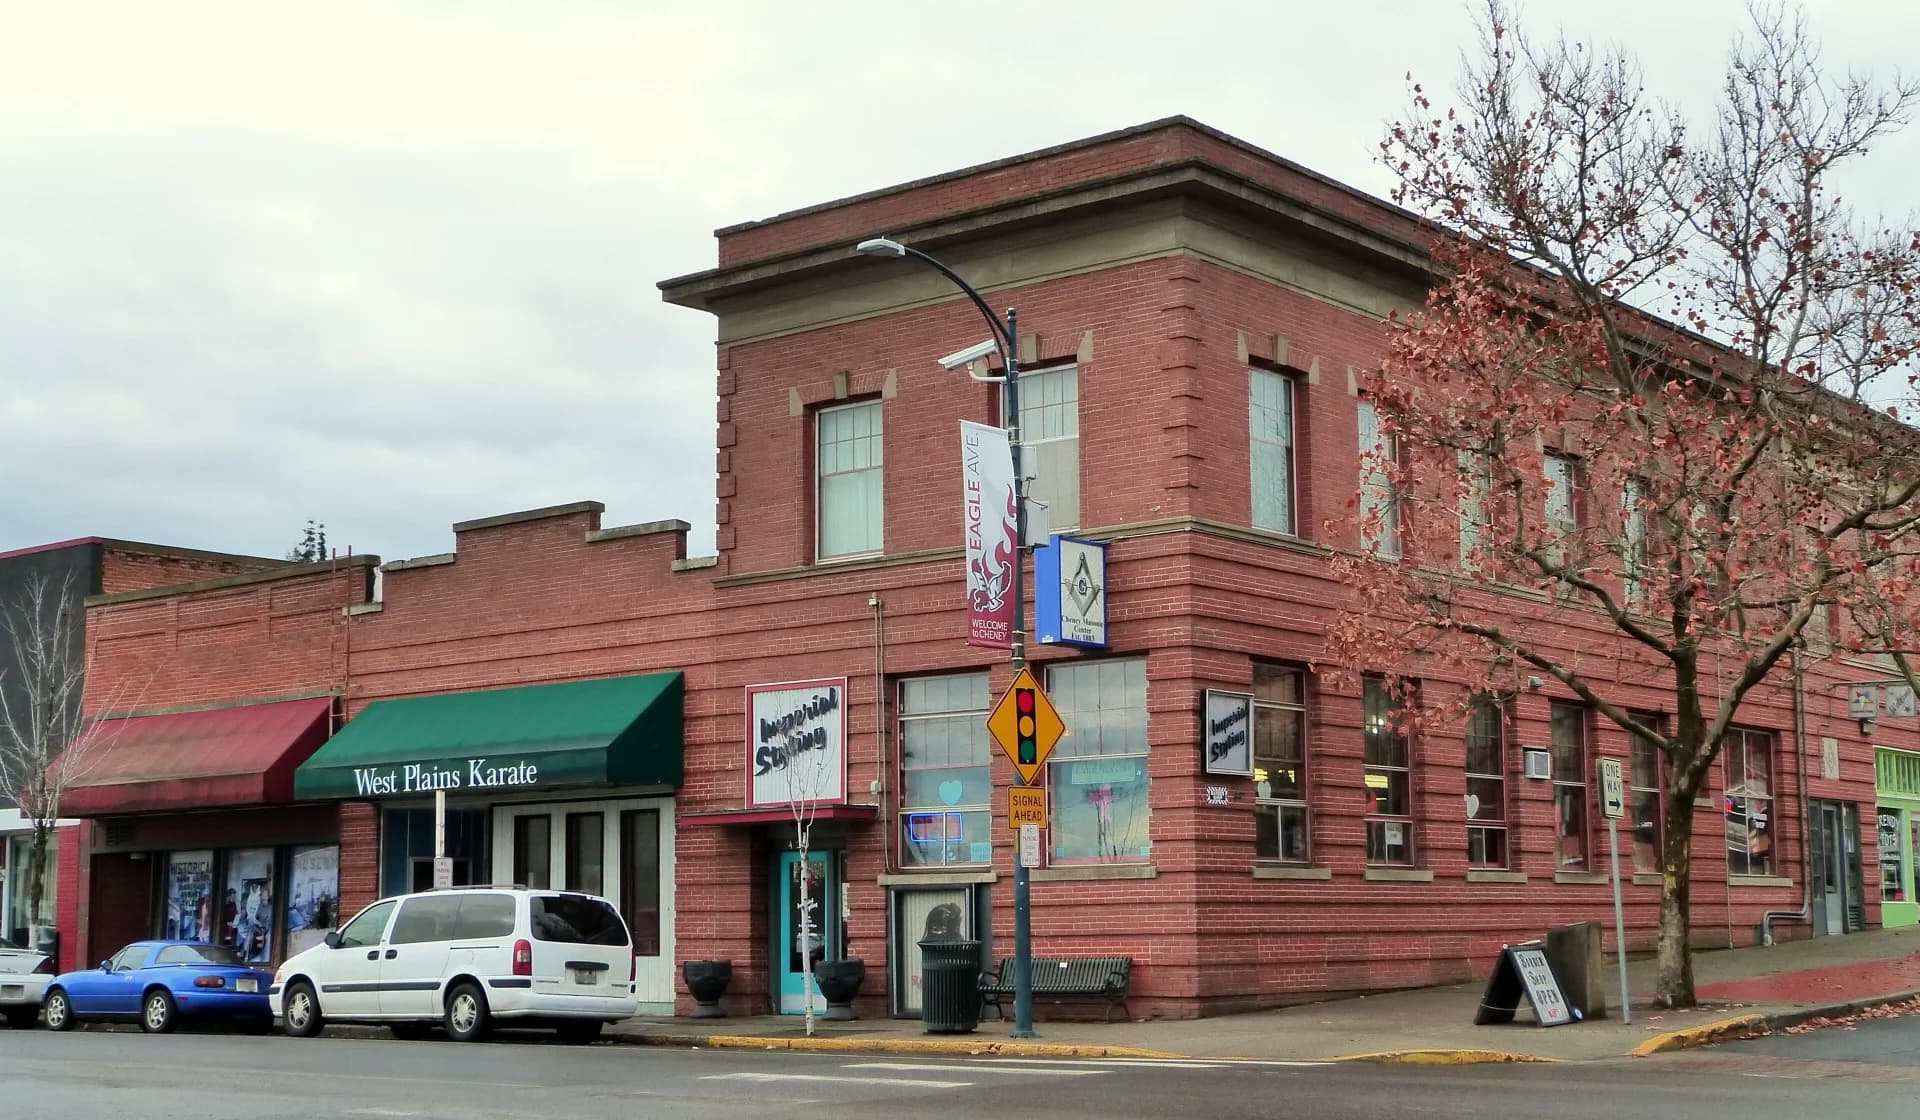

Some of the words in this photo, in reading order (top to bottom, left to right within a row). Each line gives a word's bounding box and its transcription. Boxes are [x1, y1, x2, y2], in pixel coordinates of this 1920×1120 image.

[968, 479, 981, 551] EAGLE
[972, 618, 1008, 631] WELCOME
[972, 629, 979, 638] to
[979, 630, 1008, 640] CHENEY
[761, 688, 838, 743] Imperial
[1211, 701, 1249, 736] Imperial
[754, 727, 827, 776] Styling
[1210, 730, 1245, 763] Styling
[354, 768, 397, 795] West
[403, 764, 460, 792] Plains
[467, 759, 537, 787] Karate
[1606, 763, 1620, 778] ONE
[1607, 780, 1622, 793] WAY
[1013, 795, 1043, 807] SIGNAL
[1014, 811, 1042, 821] AHEAD
[1878, 814, 1899, 830] RENDY
[1535, 989, 1560, 1005] OPEN
